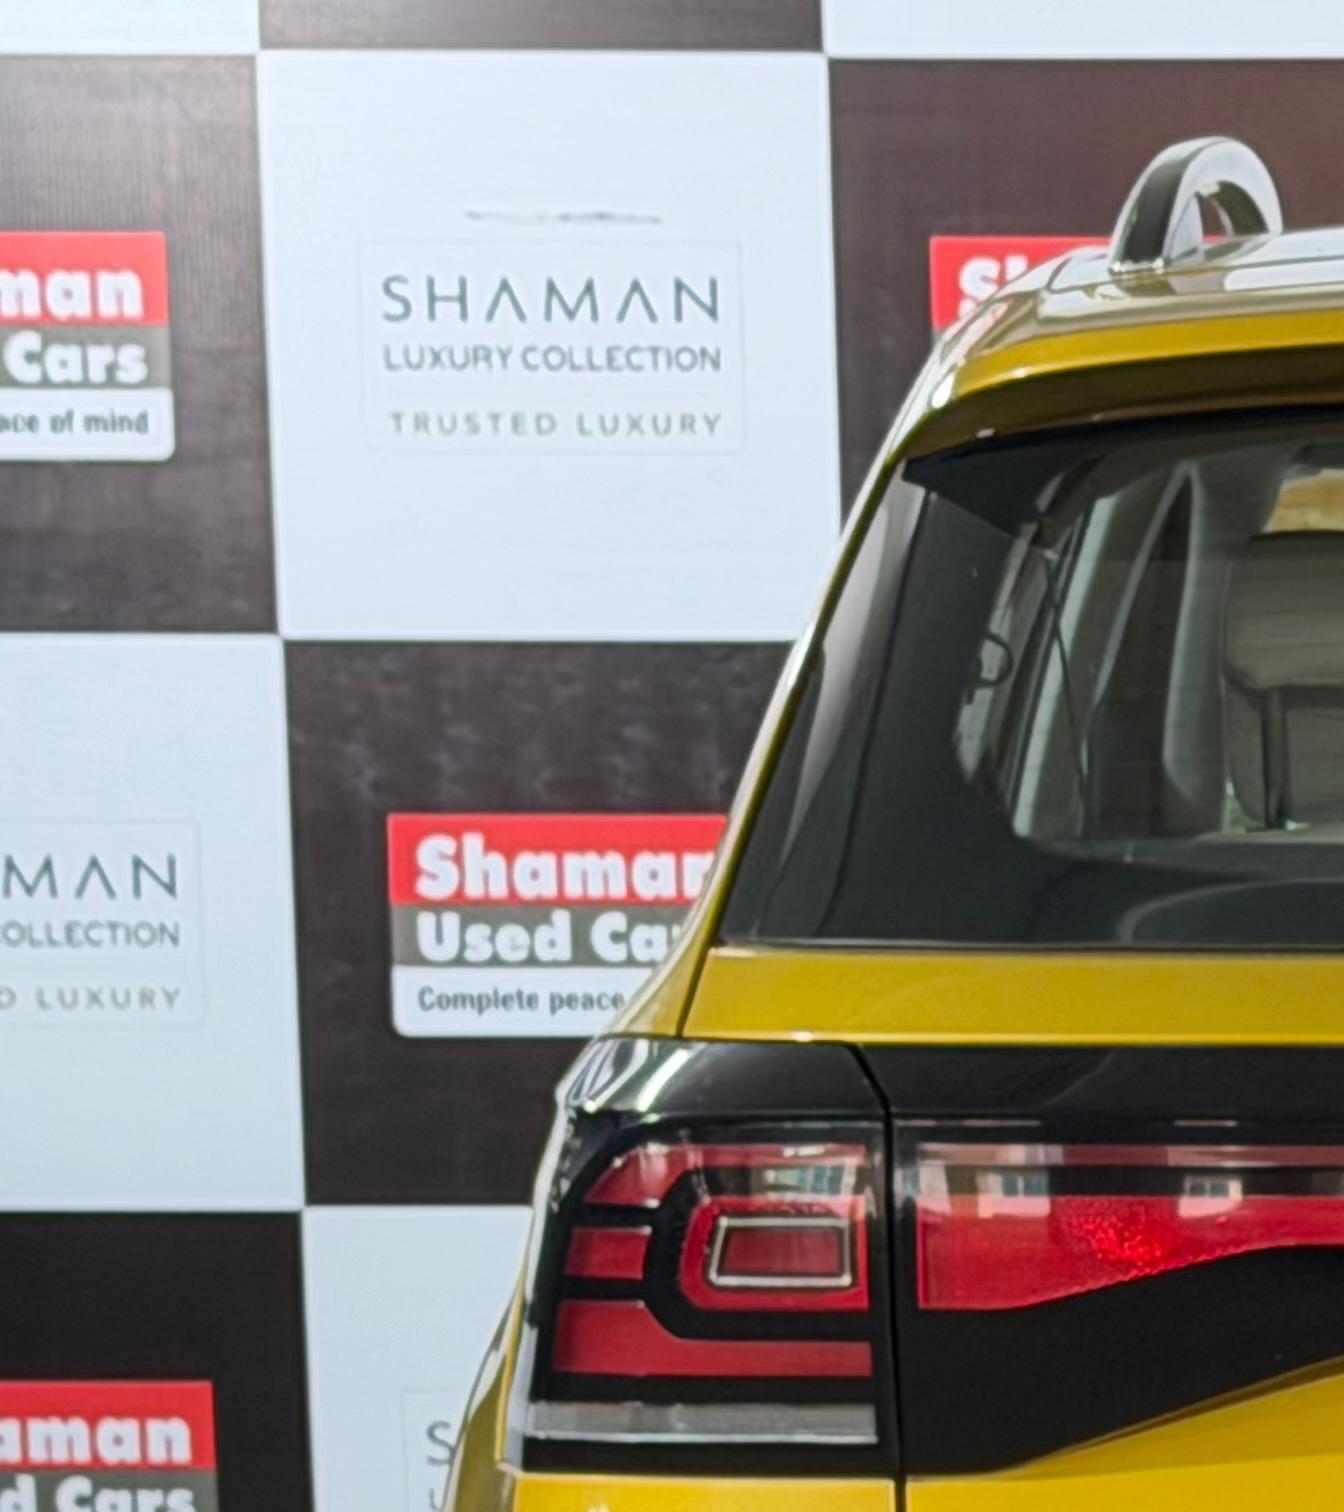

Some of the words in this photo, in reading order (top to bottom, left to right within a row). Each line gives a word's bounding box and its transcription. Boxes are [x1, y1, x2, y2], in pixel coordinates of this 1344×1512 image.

[381, 274, 719, 323] SHAMAN
[3, 330, 149, 384] Cars
[383, 344, 514, 372] LUXURY
[520, 344, 722, 372] COLLECTION
[50, 408, 75, 434] of
[83, 408, 149, 435] mind
[389, 411, 557, 437] TRUSTED
[577, 411, 722, 437] LUXURY
[416, 909, 573, 963] Used
[34, 986, 180, 1010] LUXURY
[418, 986, 539, 1014] Complete
